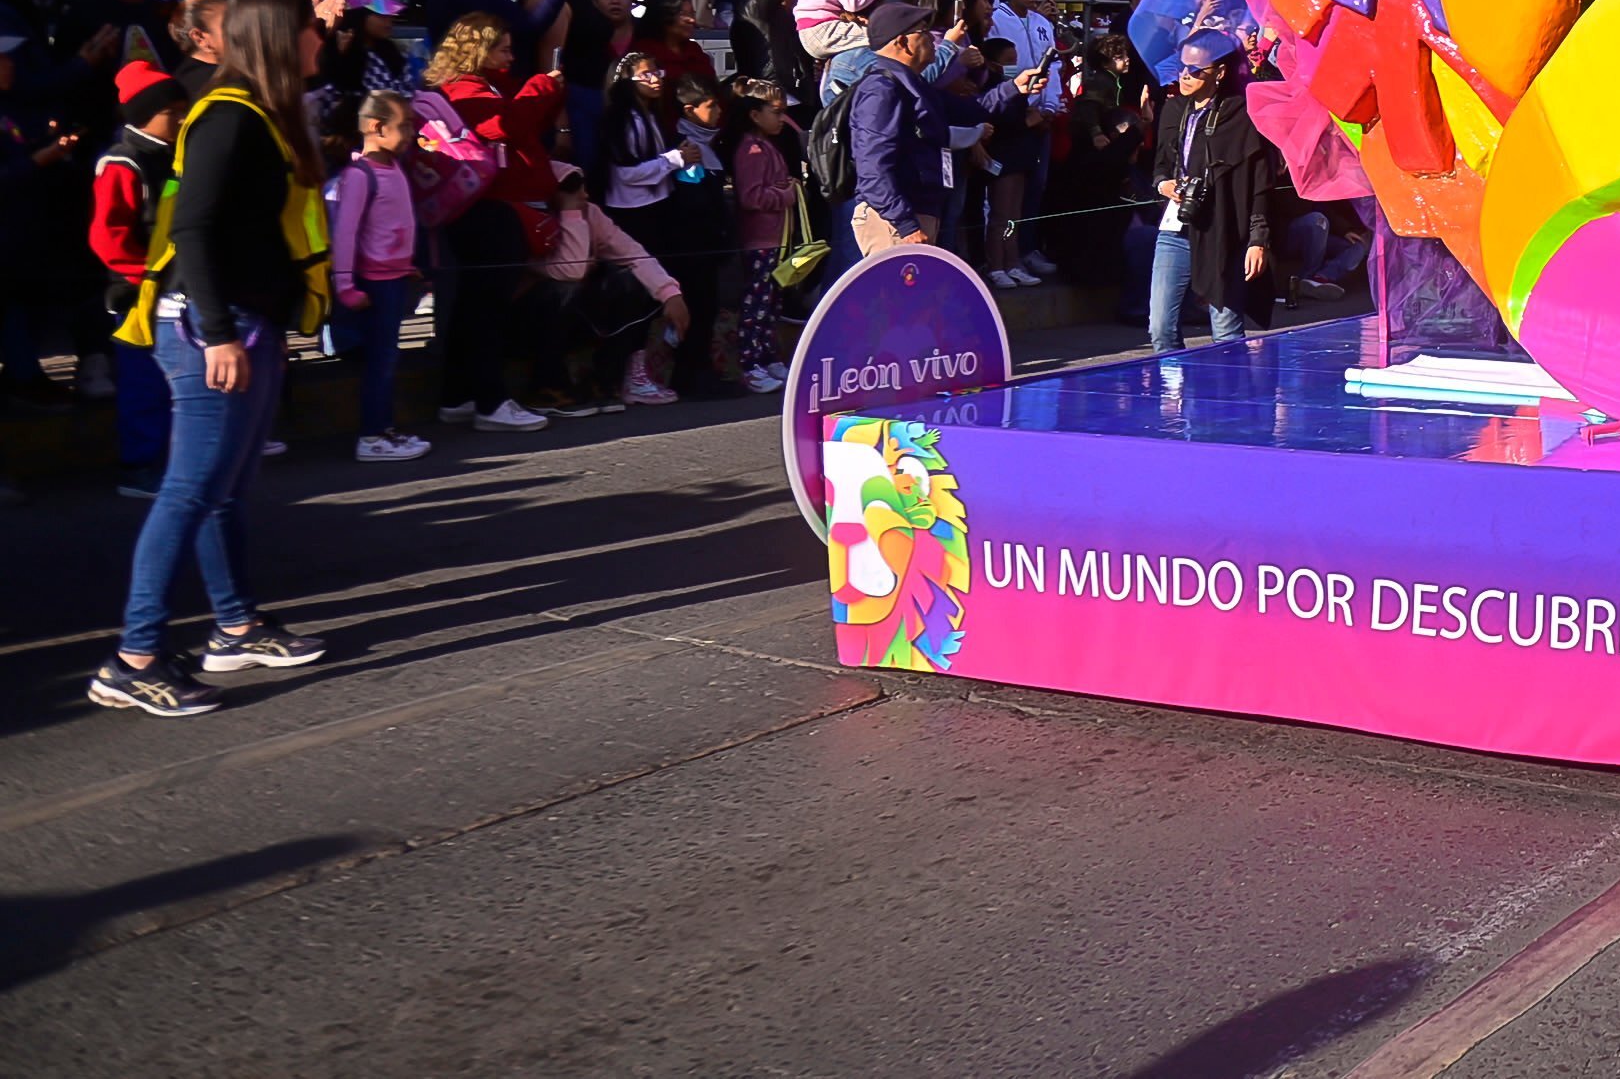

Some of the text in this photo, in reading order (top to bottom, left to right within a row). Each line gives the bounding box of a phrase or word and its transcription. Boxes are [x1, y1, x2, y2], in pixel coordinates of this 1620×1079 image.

[808, 349, 977, 413] ¡León vivo
[983, 540, 1044, 593] UN
[1058, 548, 1243, 611] MUNDO
[1257, 564, 1354, 626] POR
